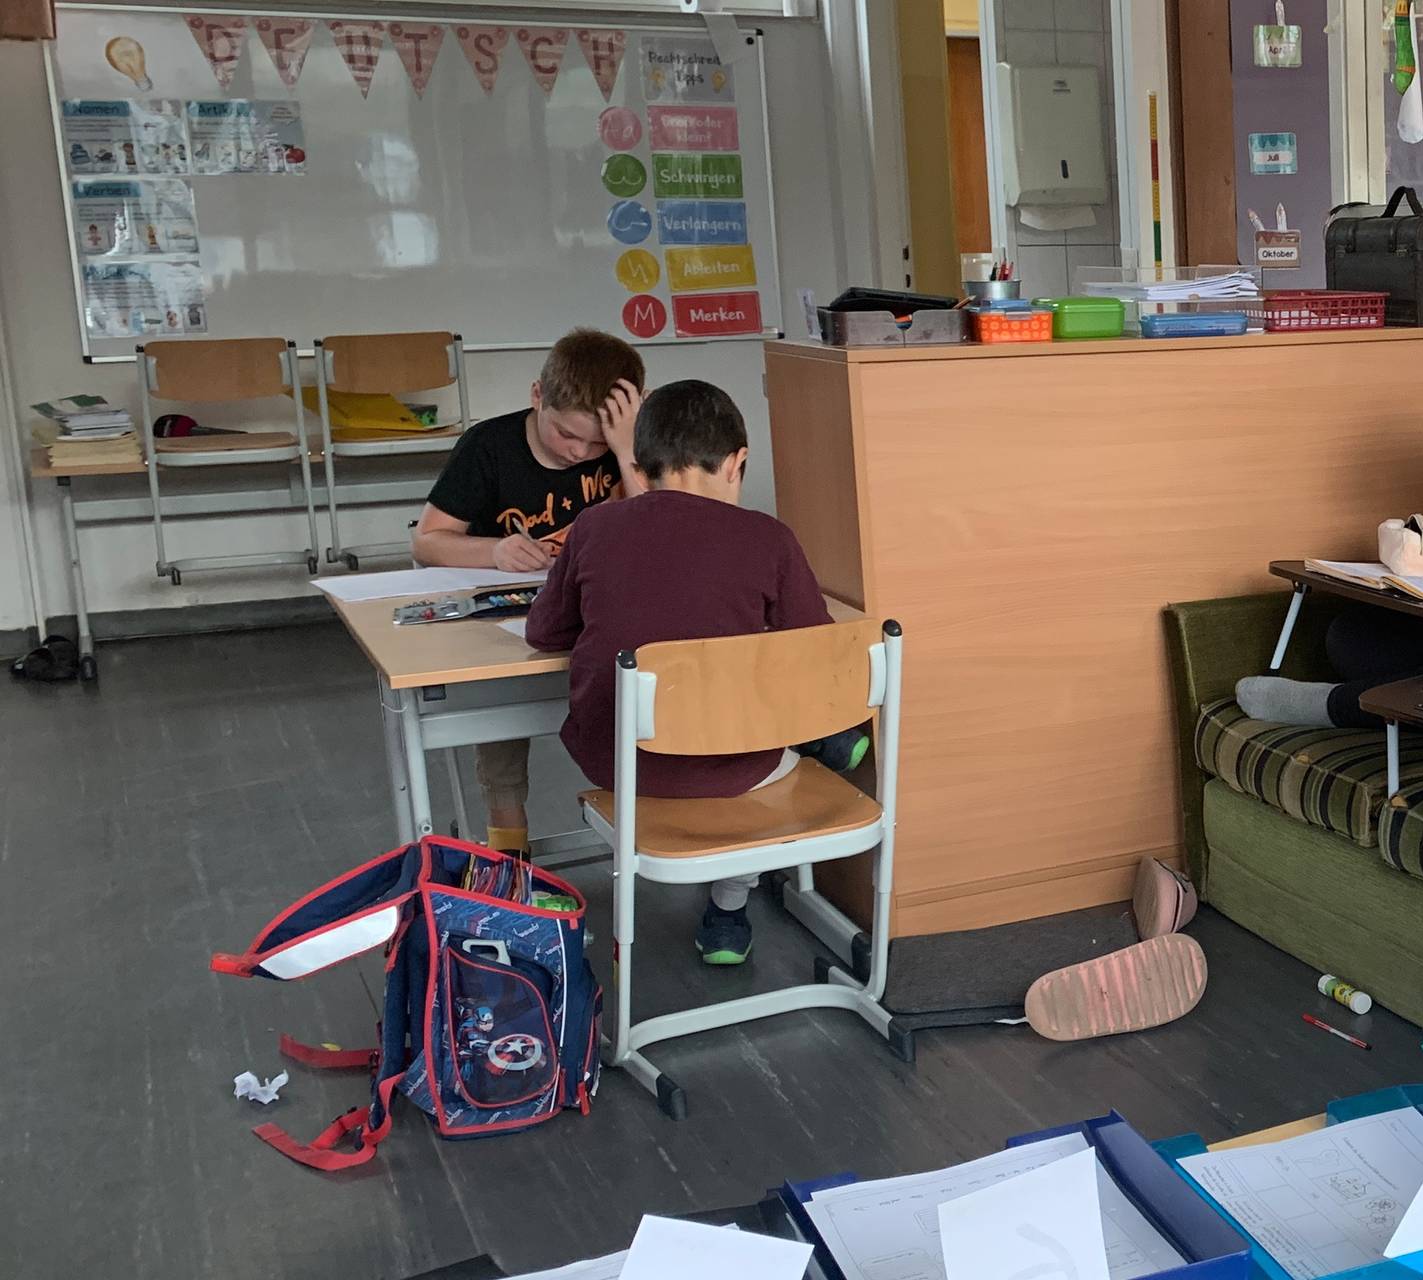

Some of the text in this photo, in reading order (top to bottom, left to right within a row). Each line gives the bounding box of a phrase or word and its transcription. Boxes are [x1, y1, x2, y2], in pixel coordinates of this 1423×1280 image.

[206, 24, 616, 76] DEUTSCH
[660, 167, 736, 189] Schwingen
[1261, 250, 1295, 258] Oktober
[683, 260, 741, 277] Ableiten
[689, 307, 746, 323] Merken
[496, 492, 556, 537] Dad
[581, 465, 613, 503] Me
